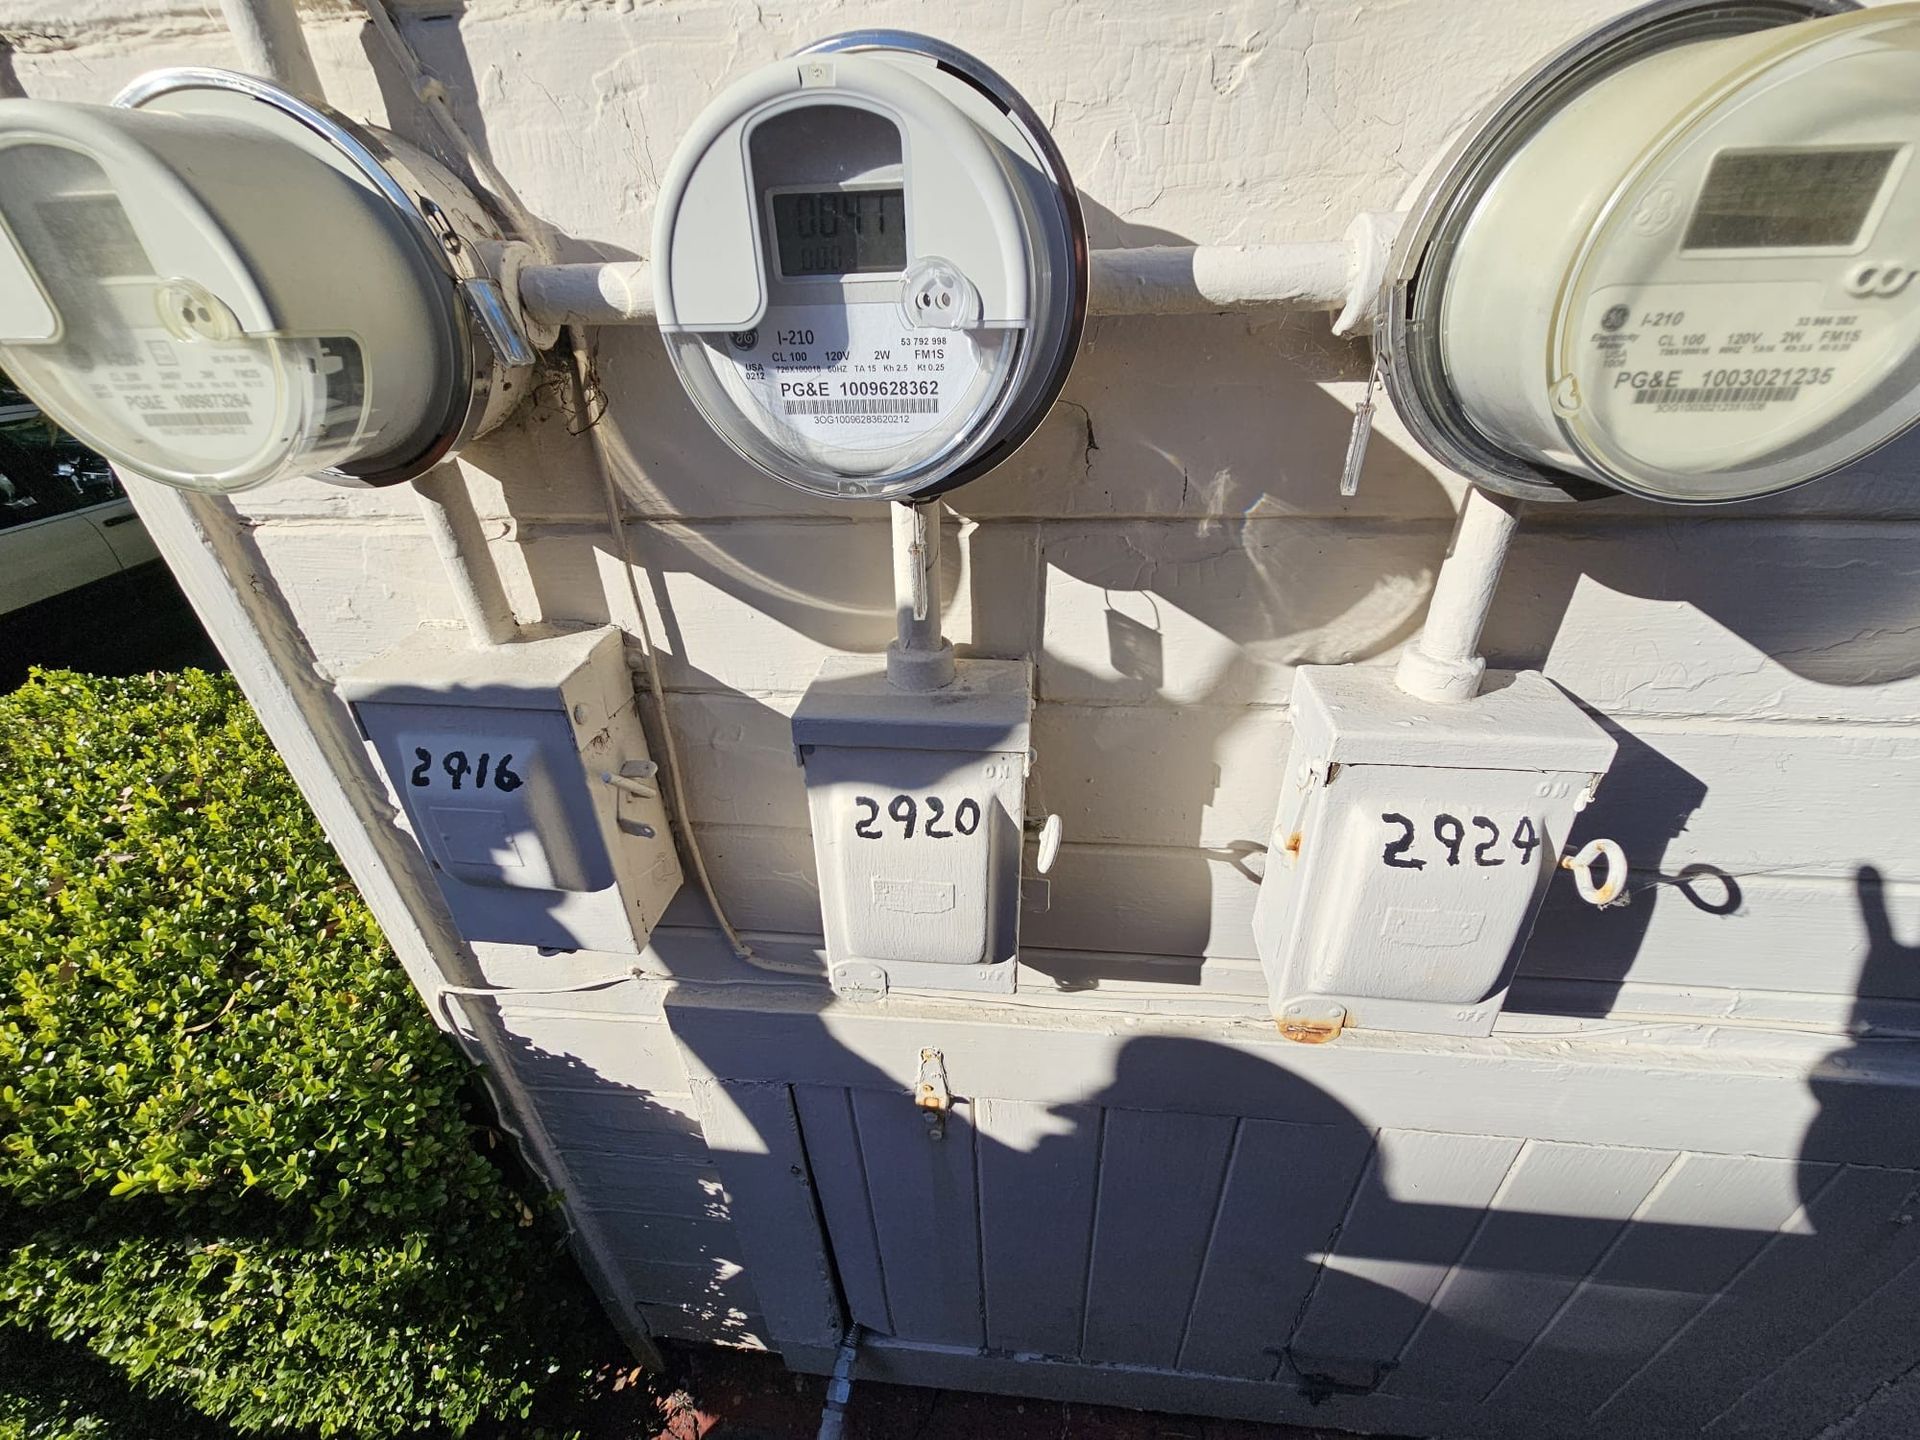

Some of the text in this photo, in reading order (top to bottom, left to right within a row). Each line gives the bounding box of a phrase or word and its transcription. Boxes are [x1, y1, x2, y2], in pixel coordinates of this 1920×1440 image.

[1640, 311, 1685, 327] I-210
[777, 329, 814, 345] I-210
[900, 336, 947, 346] 53 792 998
[1658, 334, 1675, 347] CL
[1682, 333, 1705, 346] 100
[771, 348, 945, 362] CL 100 120V 2W FM1S
[745, 363, 764, 372] USA
[854, 364, 865, 373] TA
[867, 364, 877, 372] 15
[883, 364, 895, 372] Kh
[896, 364, 908, 372] 2.5
[928, 363, 945, 371] 0.25
[745, 372, 765, 380] 0212
[1614, 367, 1835, 389] PG&E 1003021235
[781, 380, 939, 397] PG&E 1009628362
[412, 747, 524, 792] 2916
[855, 794, 981, 839] 2920
[1382, 812, 1541, 871] 2924
